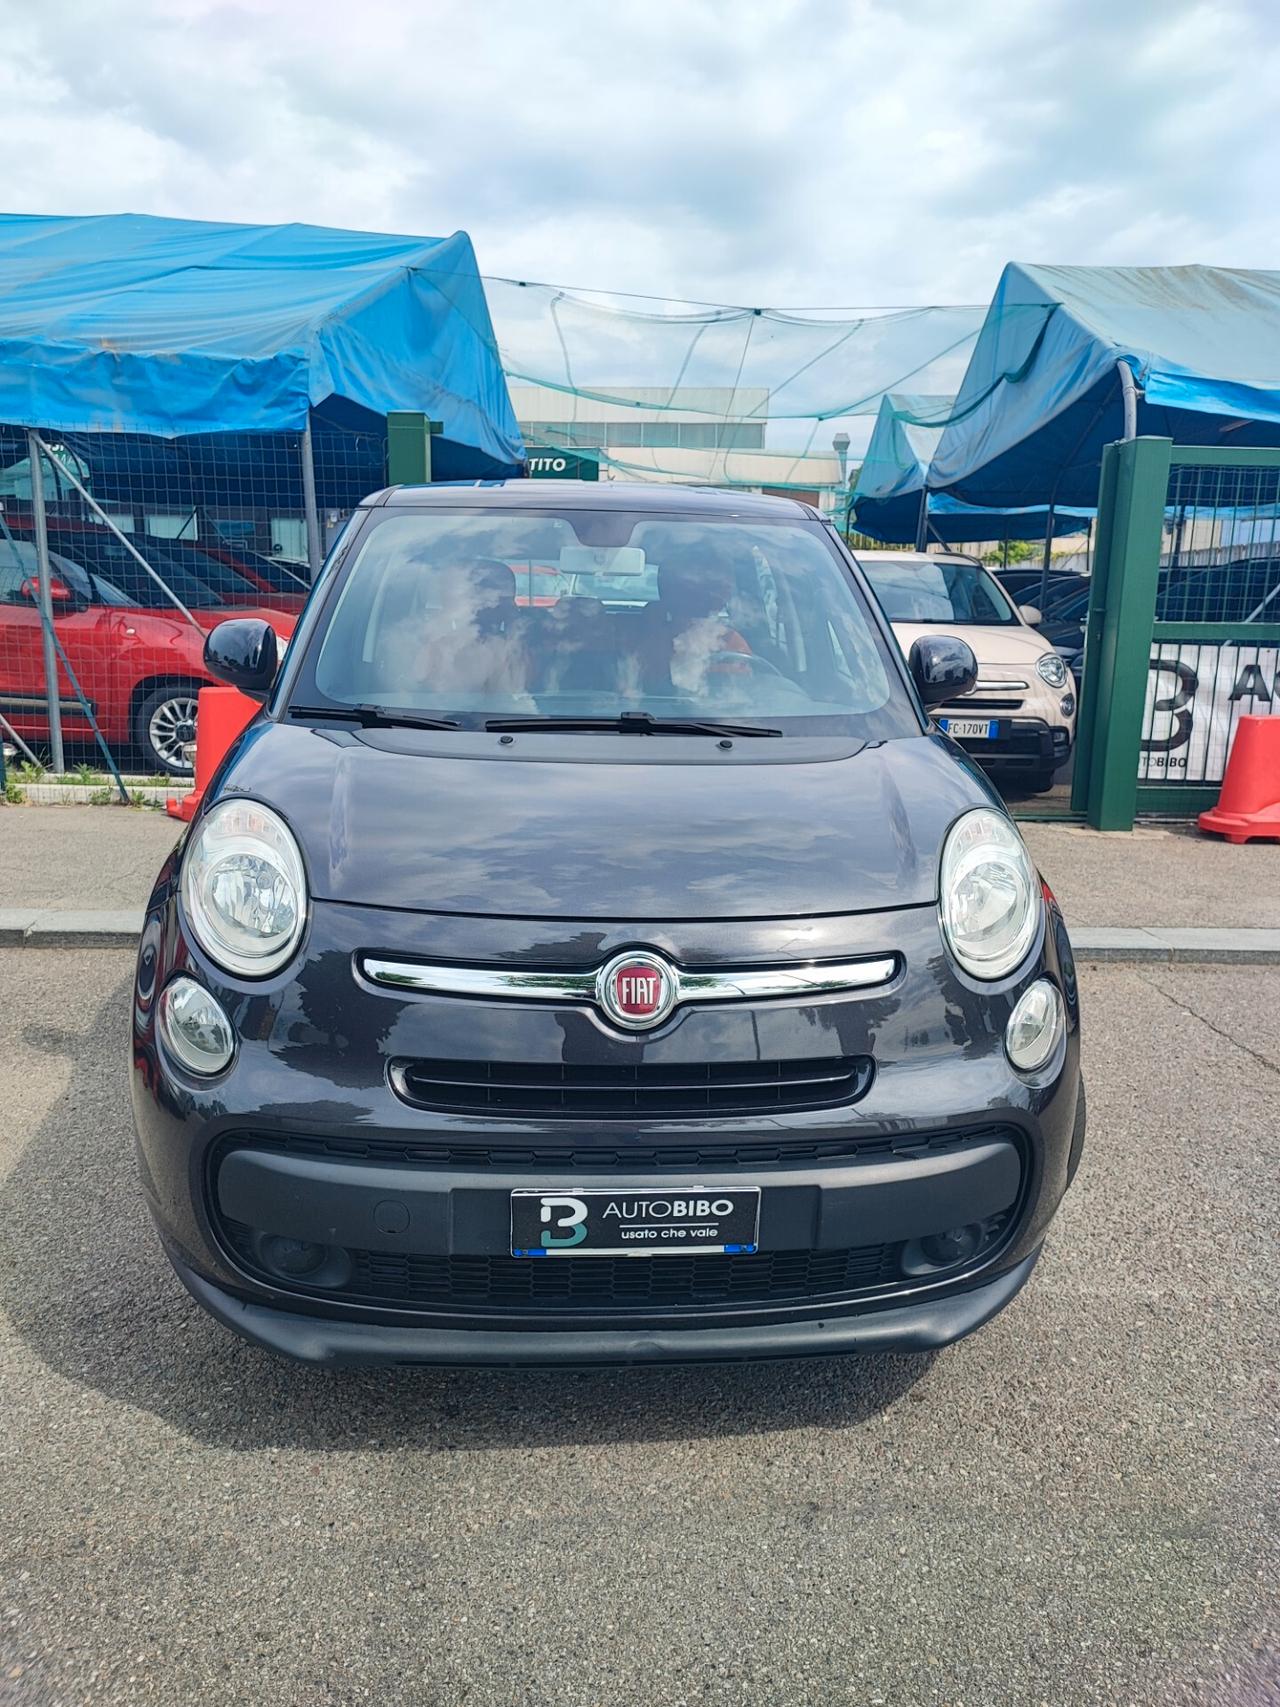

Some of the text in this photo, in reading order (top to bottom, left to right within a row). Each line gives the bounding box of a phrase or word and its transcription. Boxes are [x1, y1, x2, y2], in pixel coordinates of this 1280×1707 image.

[622, 977, 656, 1005] FIAT
[602, 1199, 734, 1219] AUTOBIBO
[621, 1227, 719, 1240] usato che vale
